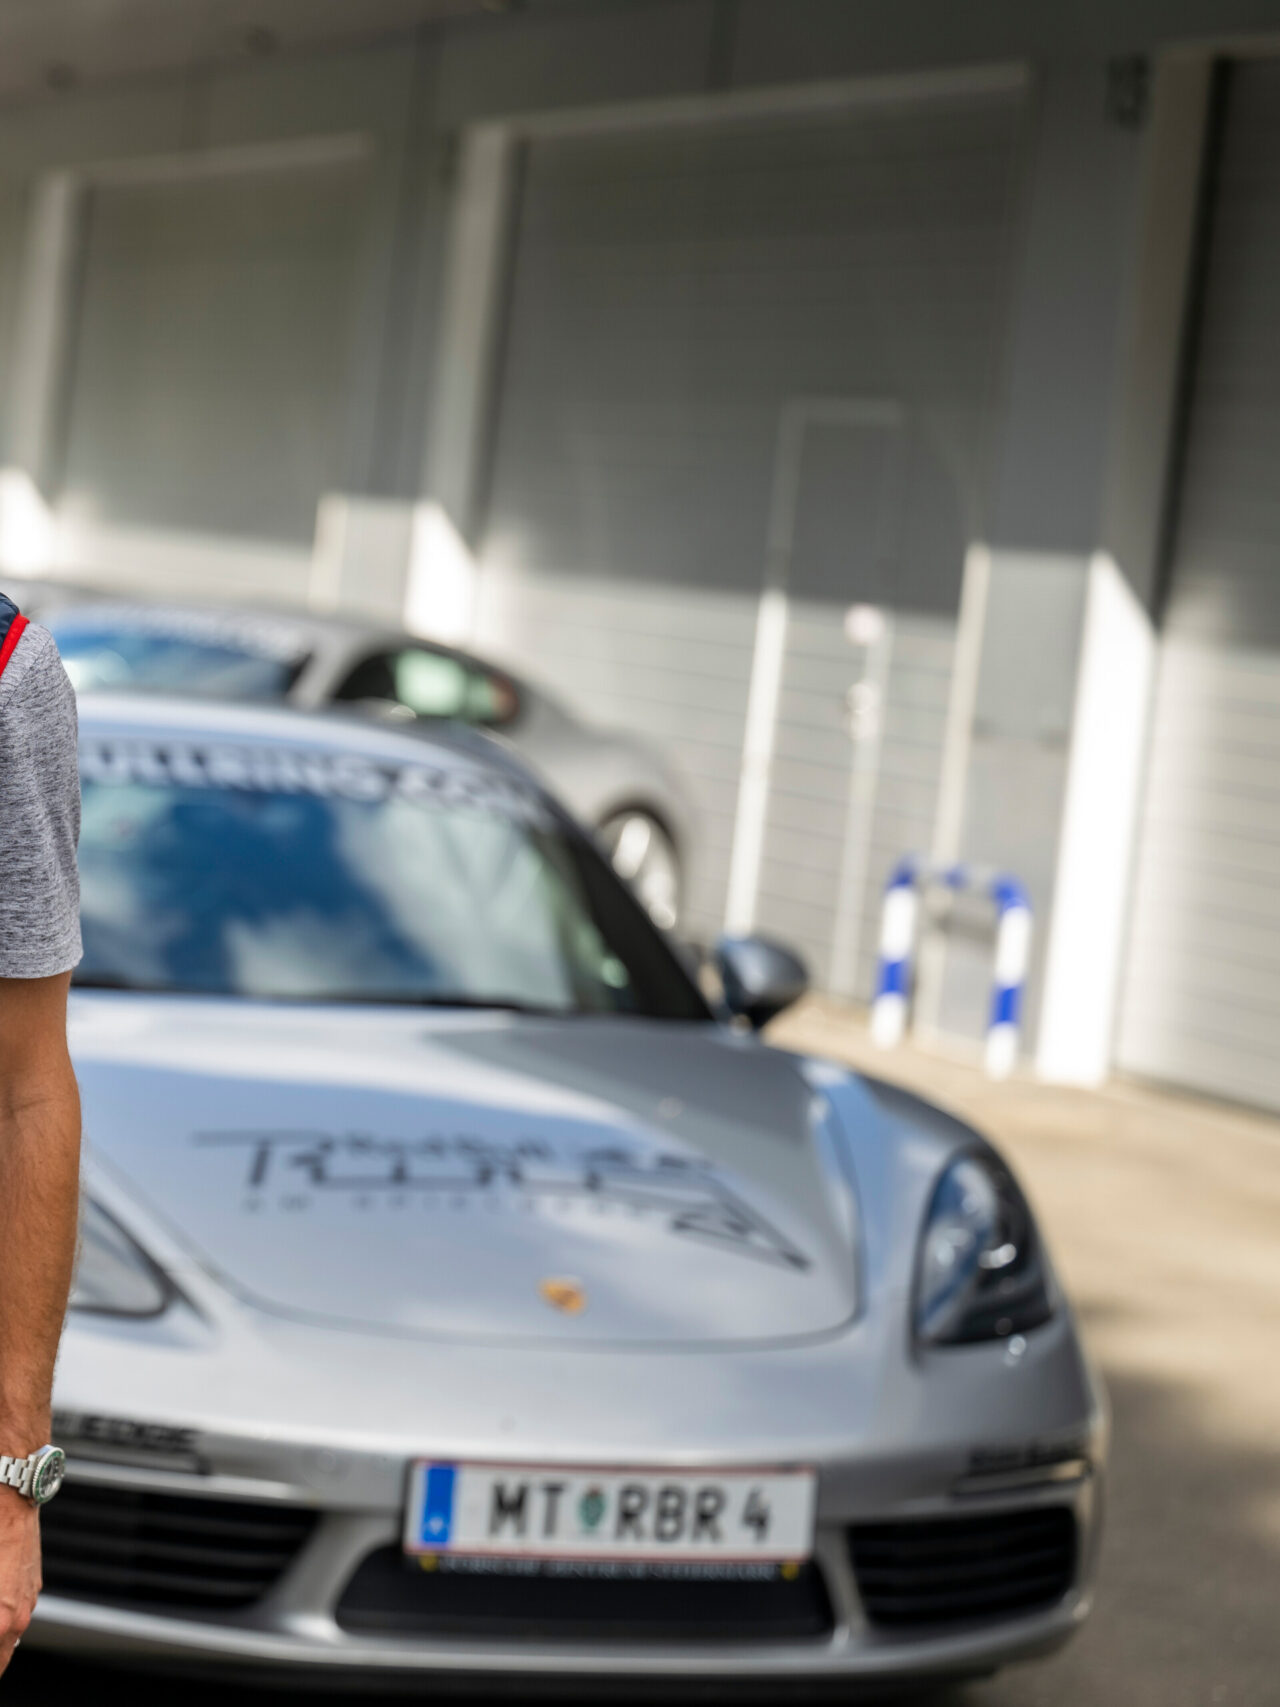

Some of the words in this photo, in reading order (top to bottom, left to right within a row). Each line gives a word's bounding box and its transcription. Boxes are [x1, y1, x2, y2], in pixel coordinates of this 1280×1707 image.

[489, 1478, 569, 1538] MT
[615, 1481, 729, 1544] RBR
[741, 1486, 772, 1544] 4
